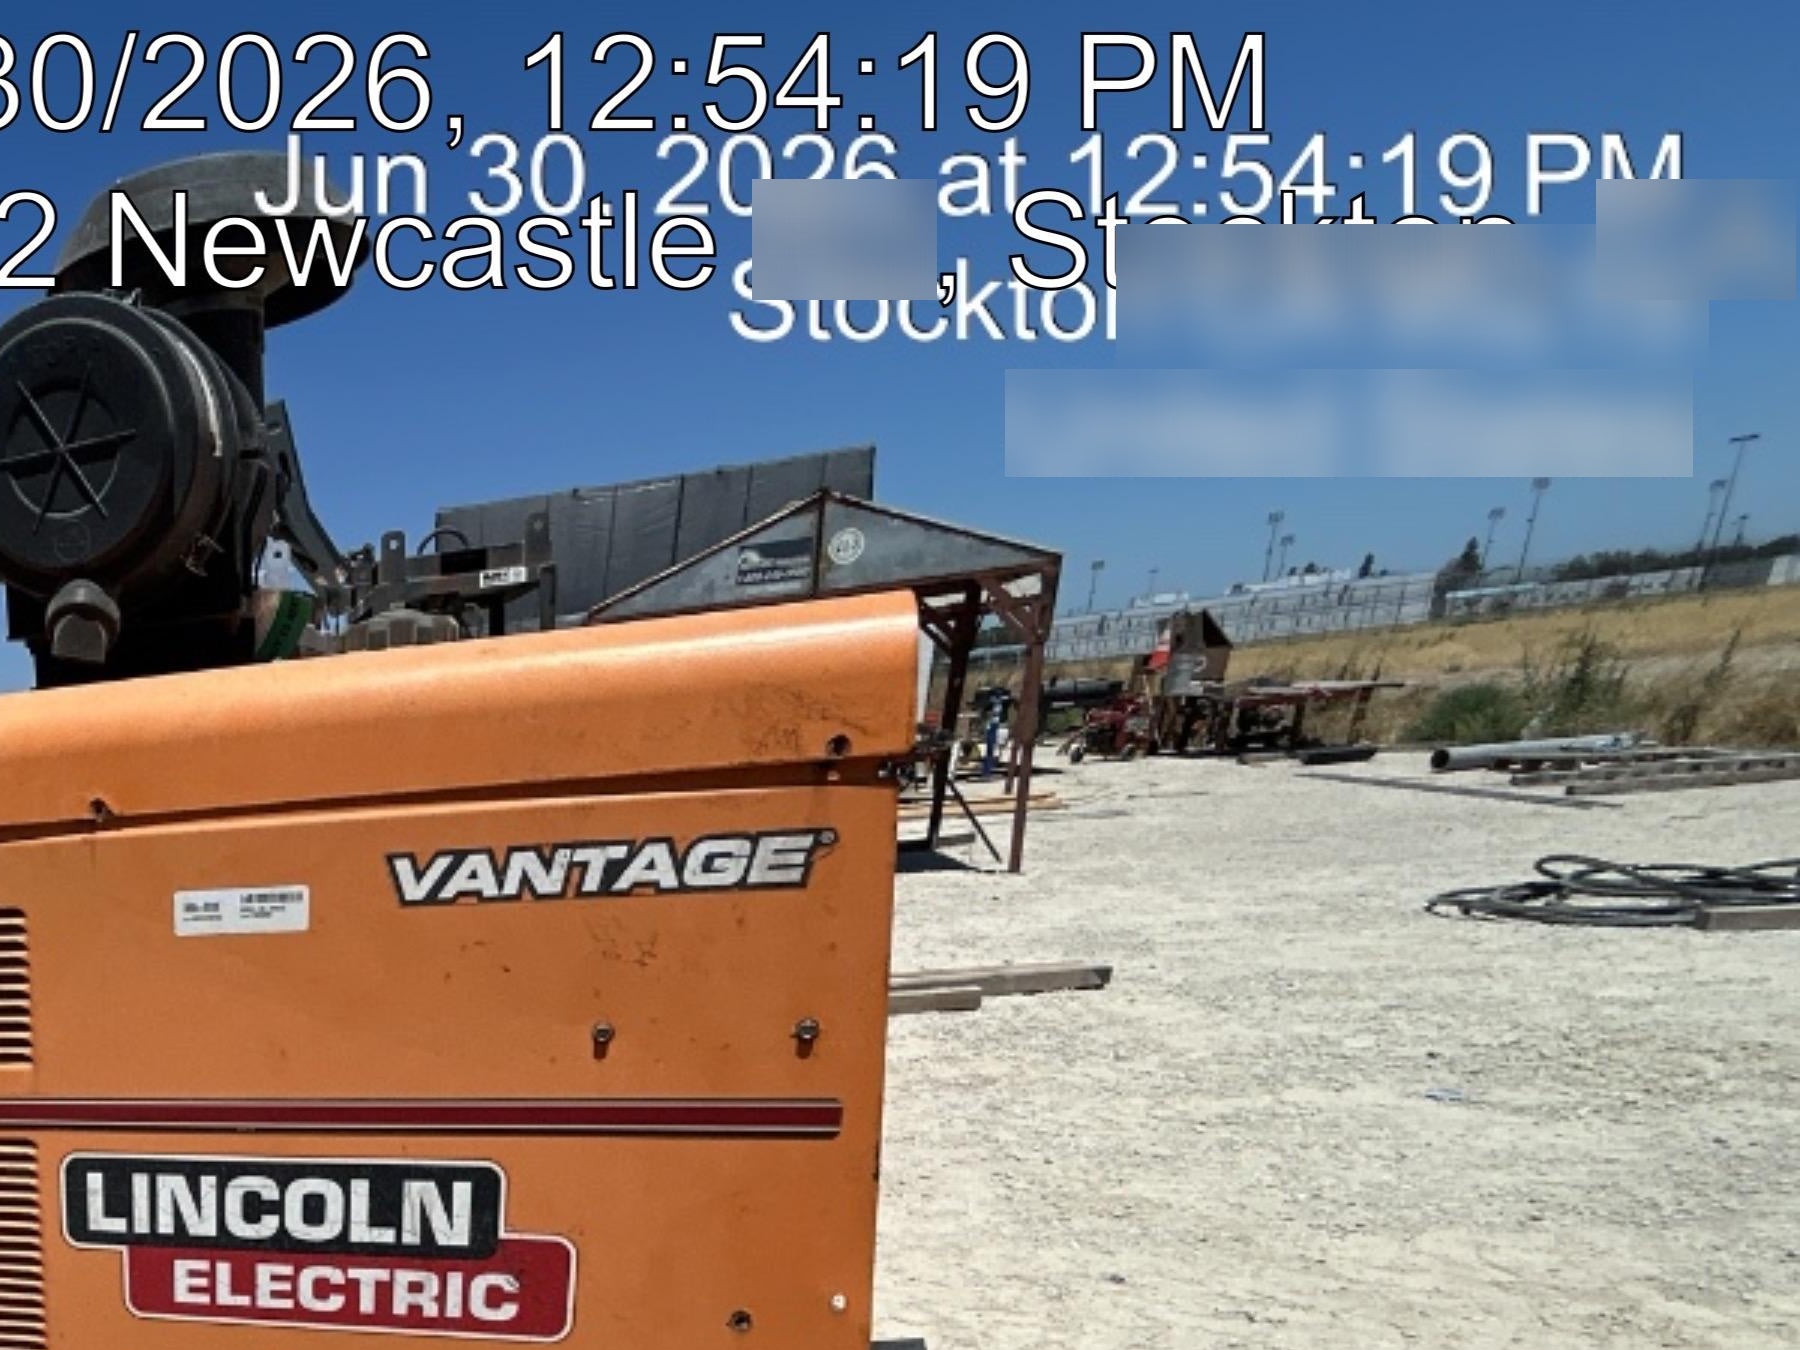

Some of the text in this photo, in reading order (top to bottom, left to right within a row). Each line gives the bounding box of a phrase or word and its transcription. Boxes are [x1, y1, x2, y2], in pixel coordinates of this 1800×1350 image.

[392, 834, 814, 901] VANTAGE
[85, 1171, 472, 1247] LINCOLN
[172, 1259, 520, 1321] ELECTRIC
